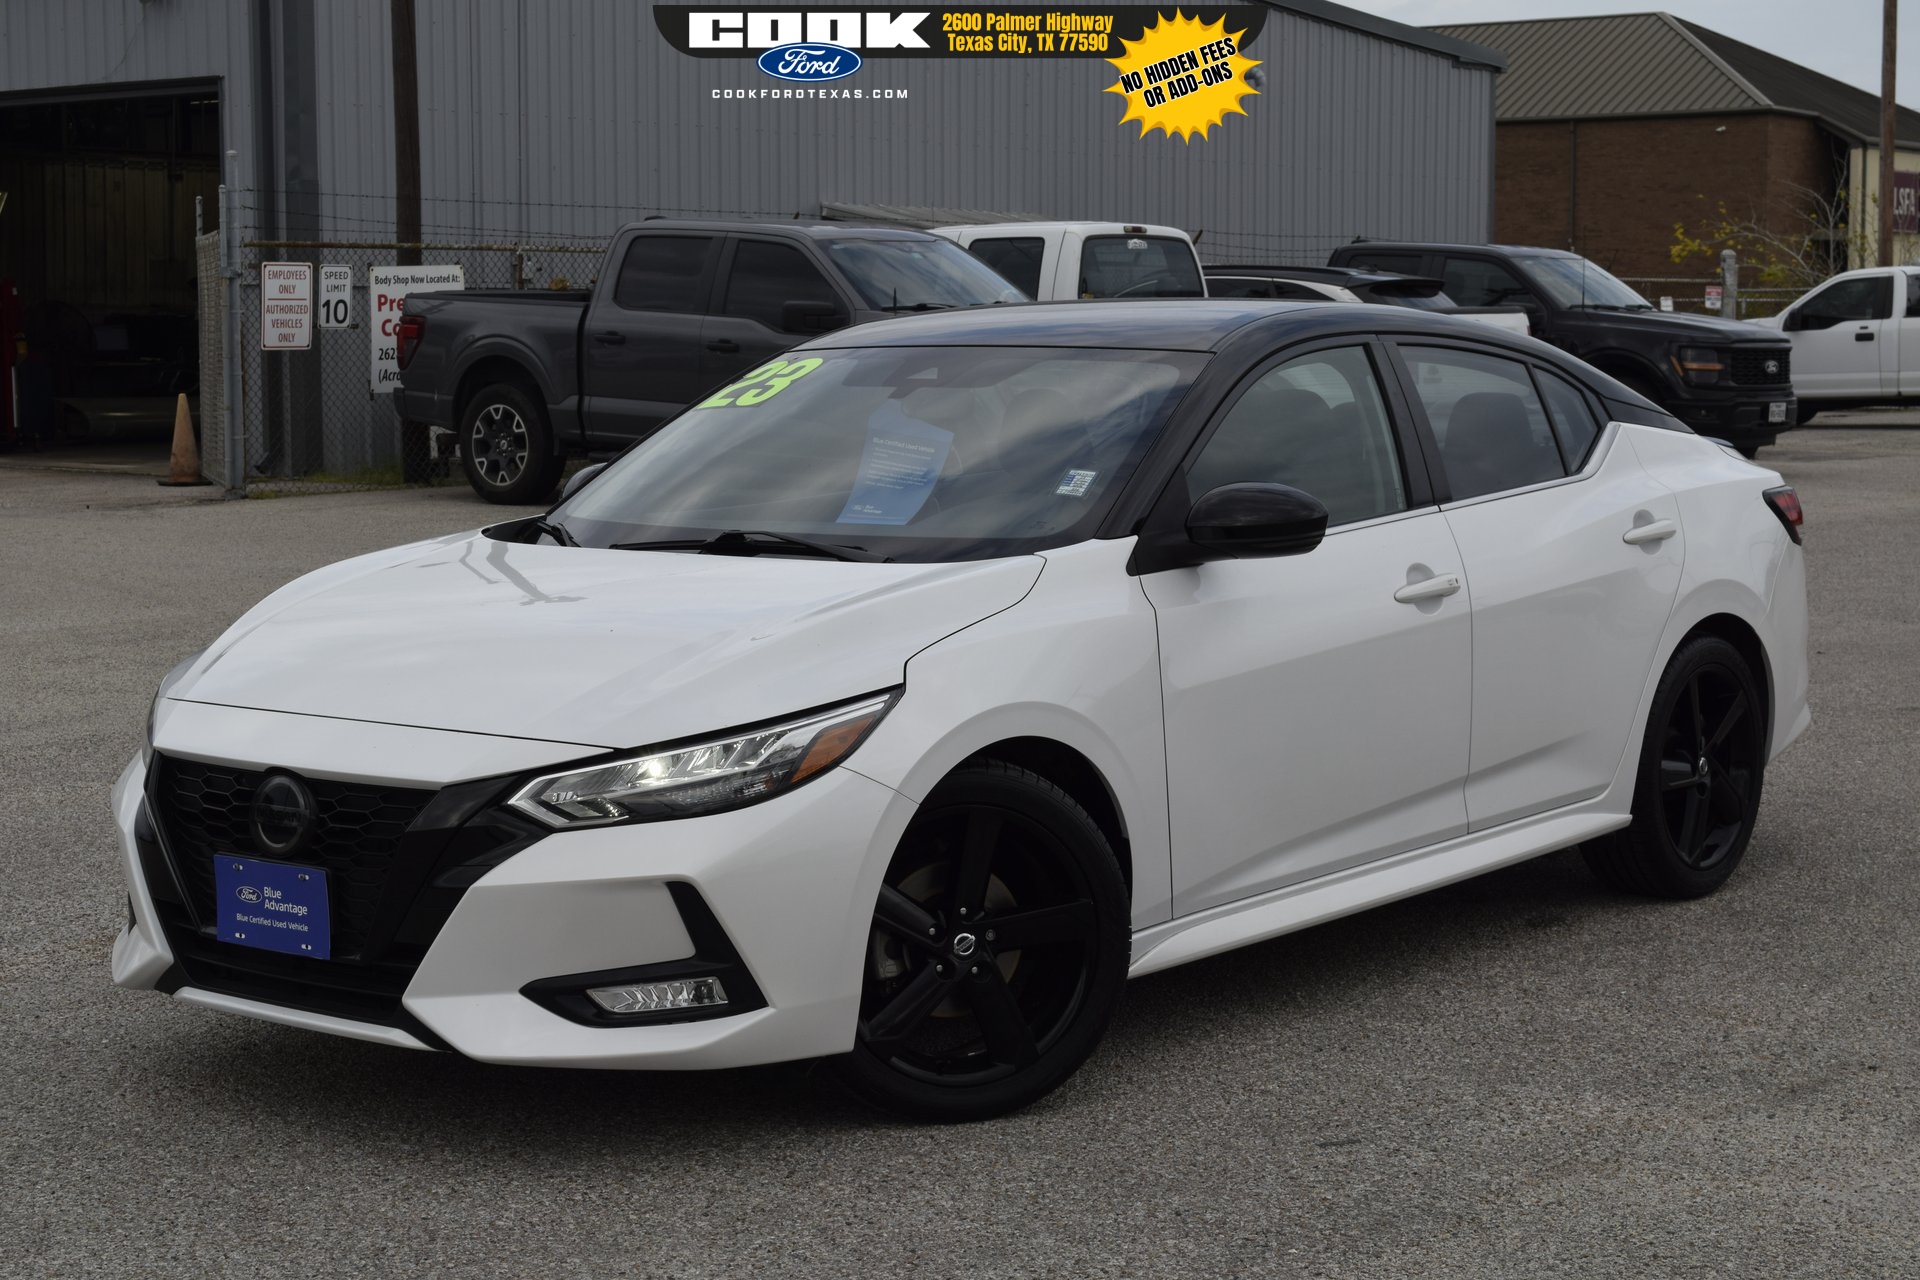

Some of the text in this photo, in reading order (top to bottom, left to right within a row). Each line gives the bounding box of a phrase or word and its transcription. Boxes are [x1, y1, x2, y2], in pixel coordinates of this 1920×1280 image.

[268, 270, 307, 281] EMPLOYEES
[324, 271, 349, 280] SPEED
[374, 274, 461, 286] Body Shop Now Located At:
[278, 284, 296, 295] ONLY
[326, 284, 346, 293] LIMIT
[265, 304, 308, 315] AUTHORIZED
[322, 299, 348, 324] 10
[271, 318, 303, 329] VEHICLES
[278, 333, 296, 343] ONLY
[697, 357, 823, 409] 23
[263, 886, 282, 899] Blue
[264, 899, 308, 916] Advantage
[236, 913, 309, 932] Blue Certified Used Vehicle
